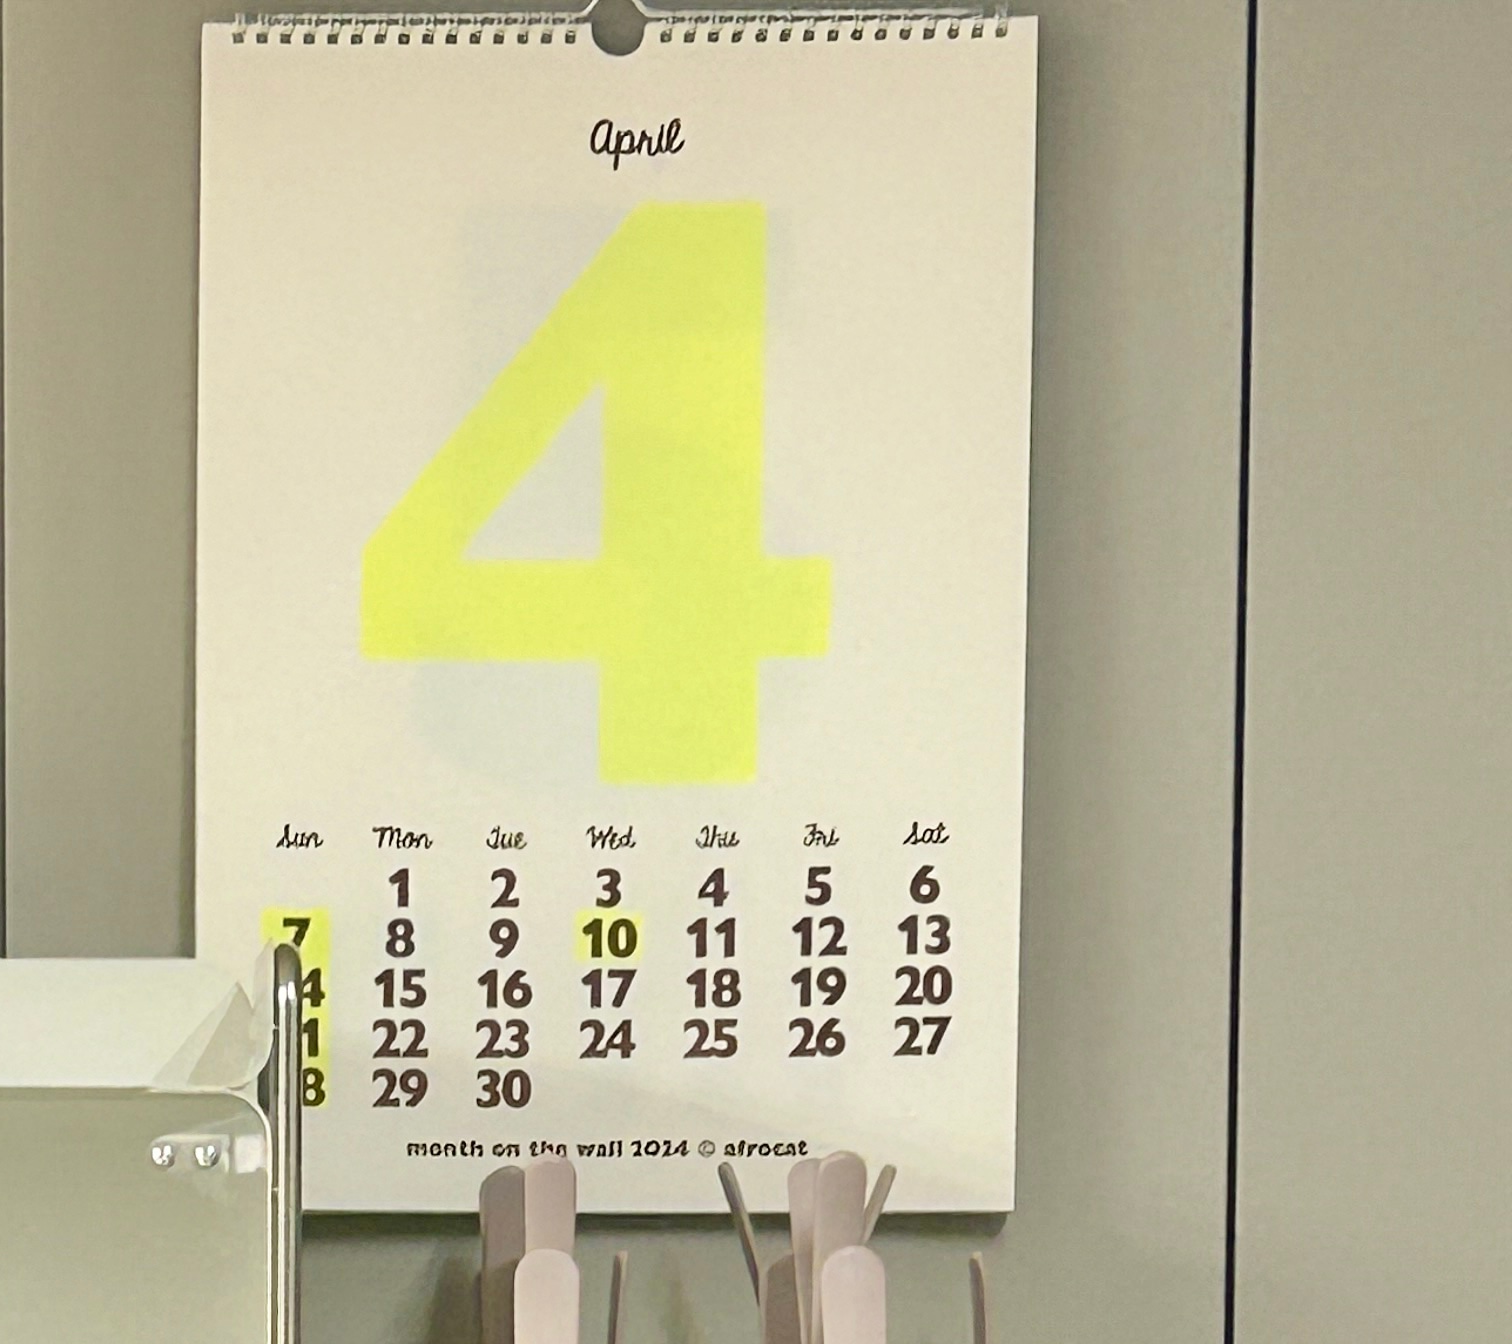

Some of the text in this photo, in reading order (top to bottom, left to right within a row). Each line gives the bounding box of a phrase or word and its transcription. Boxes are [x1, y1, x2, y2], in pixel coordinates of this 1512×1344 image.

[589, 117, 687, 172] April
[360, 202, 830, 785] 4
[275, 820, 951, 851] Sun Mon Tue Wed Thu Fri Sat
[388, 864, 940, 909] 1 2 3 4 5 6
[385, 918, 415, 958] 8
[489, 918, 520, 959] 9
[582, 918, 638, 958] 10
[686, 917, 736, 958] 11
[791, 916, 848, 957] 12
[897, 914, 951, 955] 13
[301, 964, 953, 1009] 4 15 16 17 18 19 20
[301, 1015, 952, 1060] 1 22 23 24 25 26 27
[301, 1066, 532, 1109] 8 29 30
[406, 1139, 484, 1158] month
[491, 1141, 521, 1158] on
[576, 1140, 623, 1158] wall
[630, 1139, 691, 1158] 2024
